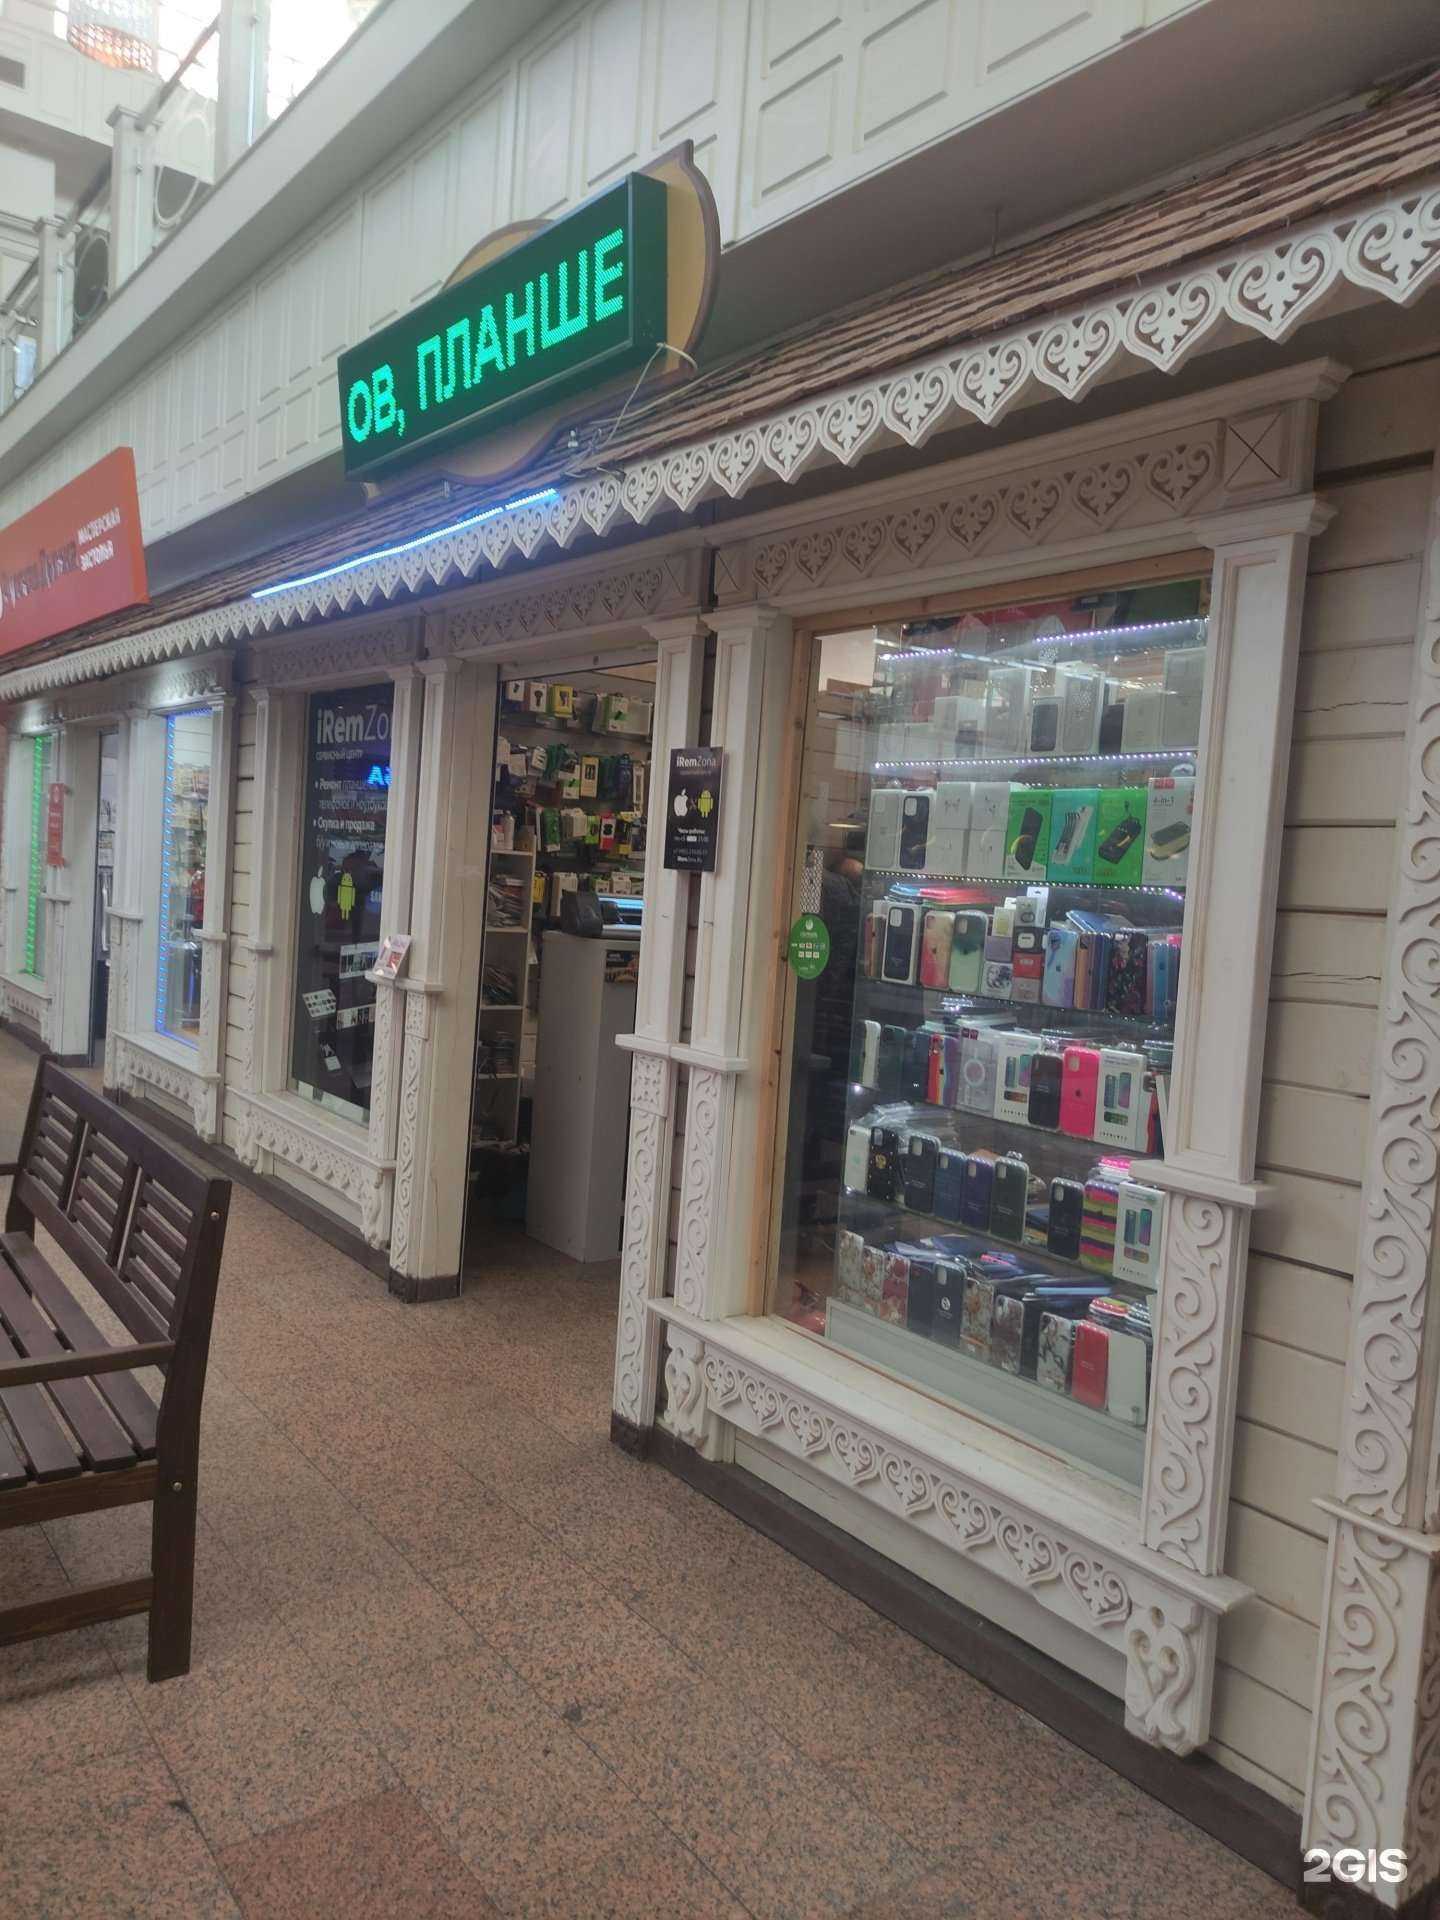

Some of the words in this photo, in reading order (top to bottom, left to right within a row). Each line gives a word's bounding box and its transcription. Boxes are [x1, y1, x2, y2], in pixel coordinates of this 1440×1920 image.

[348, 364, 405, 442] ОВ,
[417, 228, 624, 411] ПЛАНШЕ
[317, 703, 392, 744] iRemZo
